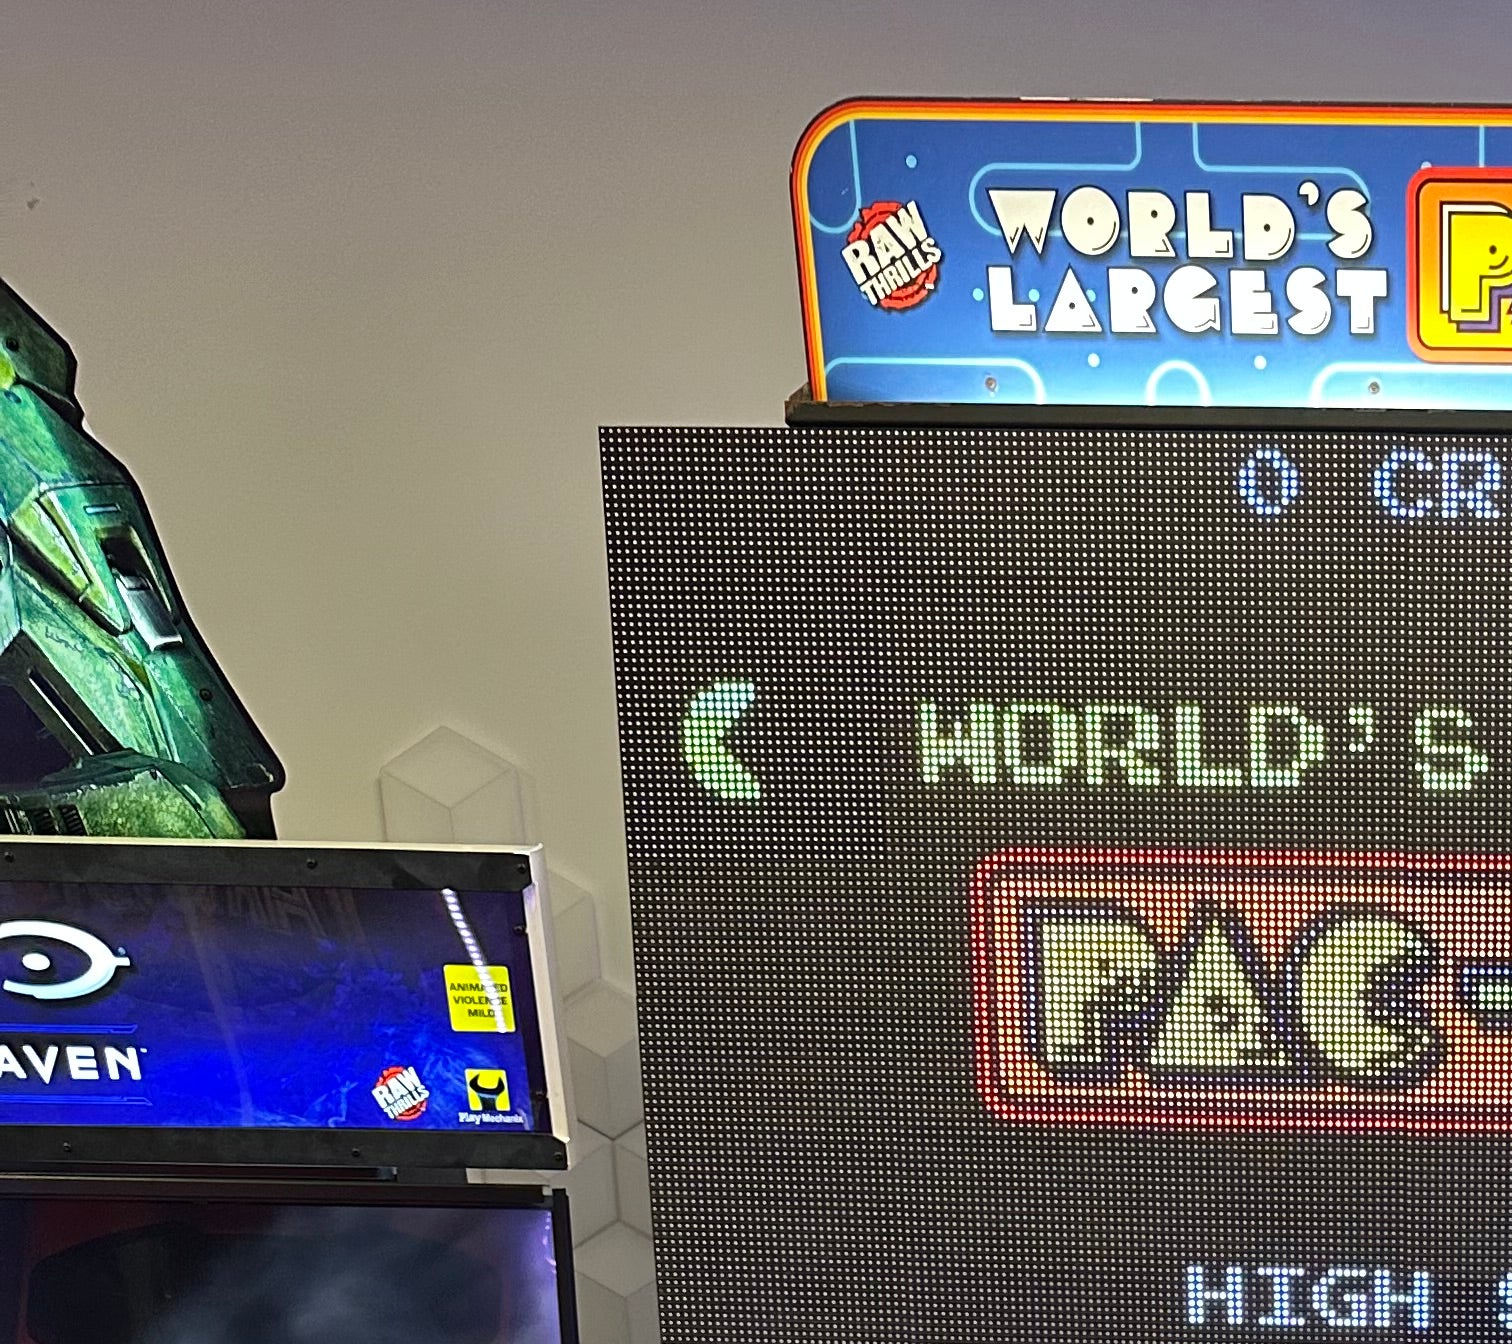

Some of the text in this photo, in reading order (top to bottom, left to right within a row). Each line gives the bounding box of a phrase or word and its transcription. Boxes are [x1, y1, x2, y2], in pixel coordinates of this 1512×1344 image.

[842, 200, 927, 285] RAW
[986, 180, 1372, 262] WORLD'S
[860, 237, 941, 305] THRILLS
[986, 266, 1388, 335] LARGEST
[918, 700, 1489, 792] WORLD'S
[450, 983, 508, 993] ANIMAED
[0, 1044, 142, 1085] AVEN
[371, 1066, 421, 1109] RAW
[383, 1084, 430, 1119] THRILLS
[1186, 1263, 1433, 1332] HIGH
